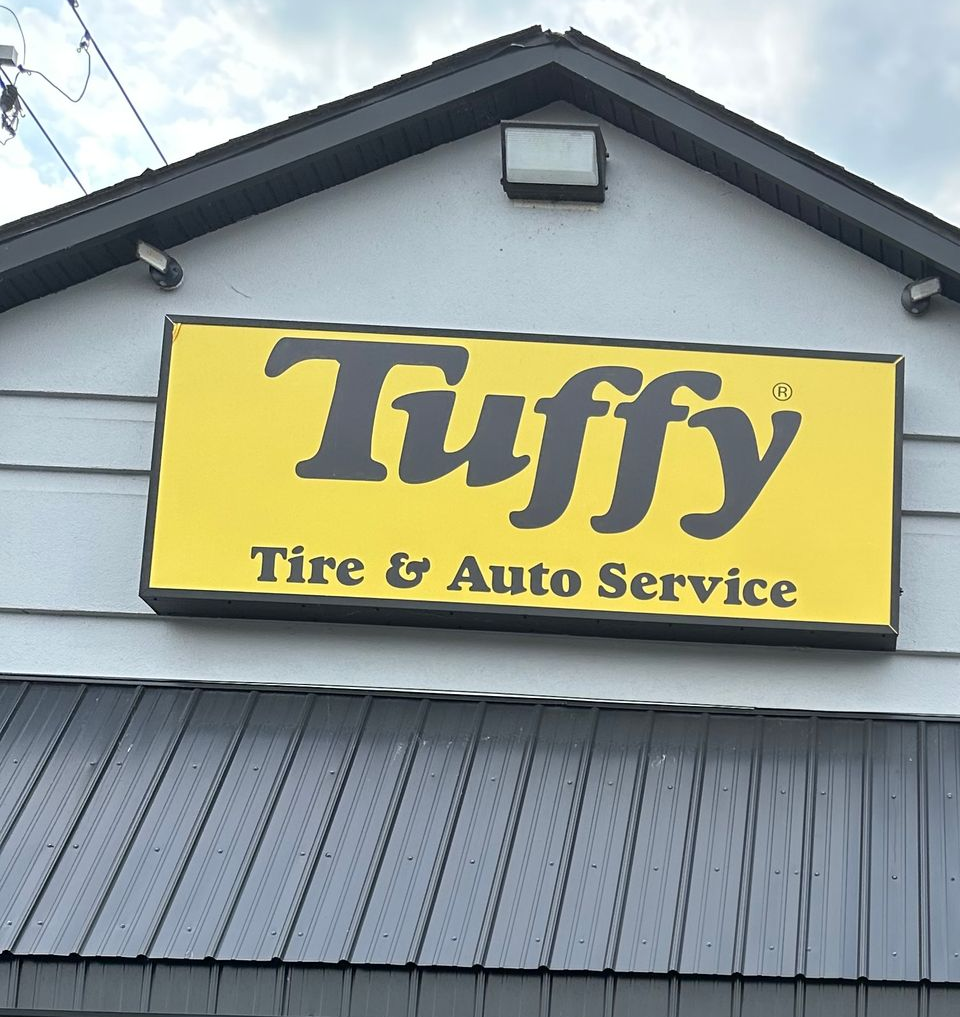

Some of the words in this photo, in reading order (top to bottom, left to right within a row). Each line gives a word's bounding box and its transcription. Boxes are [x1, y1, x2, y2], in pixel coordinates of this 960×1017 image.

[264, 336, 802, 540] Tuffy
[251, 545, 365, 587] Tire
[386, 551, 431, 590] &
[447, 555, 582, 600] Auto
[597, 562, 798, 608] Service
